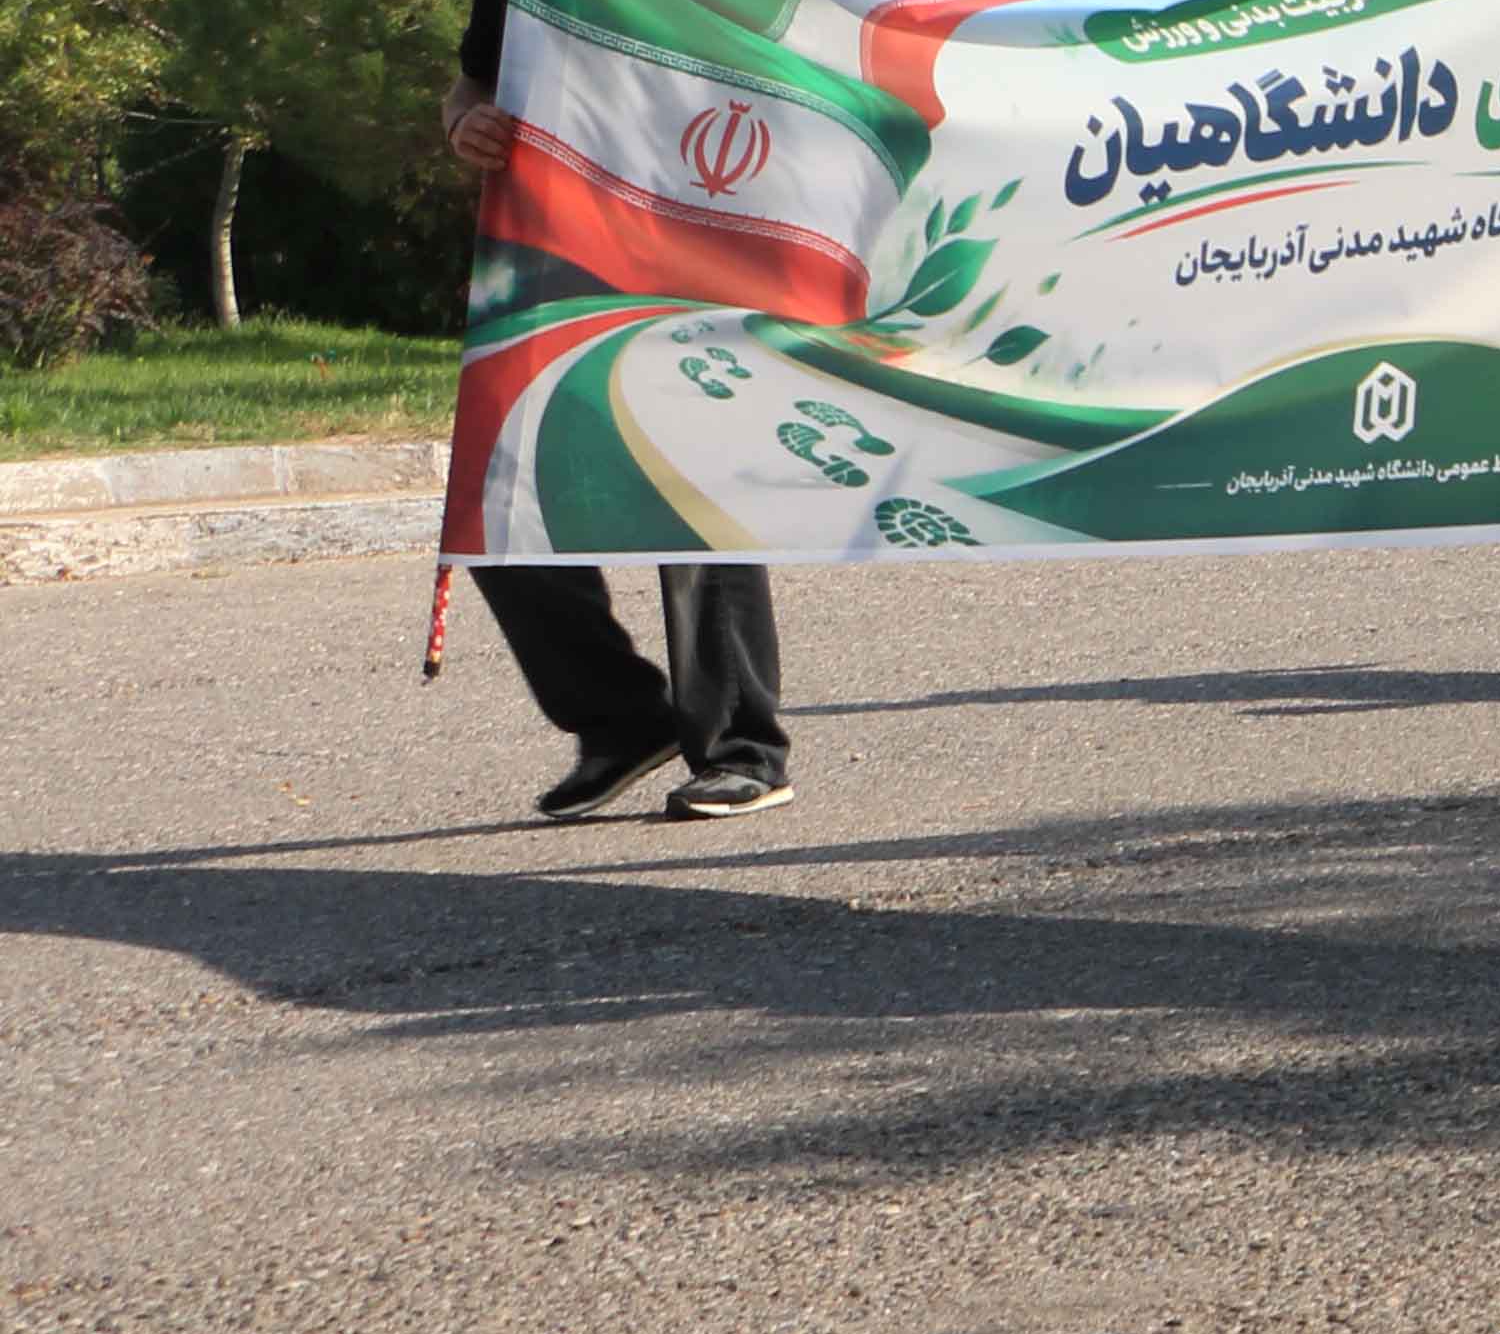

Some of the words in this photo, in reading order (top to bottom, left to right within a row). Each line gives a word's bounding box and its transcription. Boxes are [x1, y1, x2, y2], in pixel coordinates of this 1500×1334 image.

[1220, 5, 1286, 38] بدنی
[1063, 46, 1459, 206] دانشگاهیان
[1388, 207, 1467, 261] شهید
[1174, 223, 1308, 286] آذربایجان
[1309, 226, 1384, 274] مدنی
[1226, 465, 1295, 494] آذربایجان
[1294, 466, 1334, 491] مدنی
[1335, 463, 1375, 488] شهید
[1378, 459, 1434, 481] دانشگاه
[1436, 456, 1489, 482] عمومی
